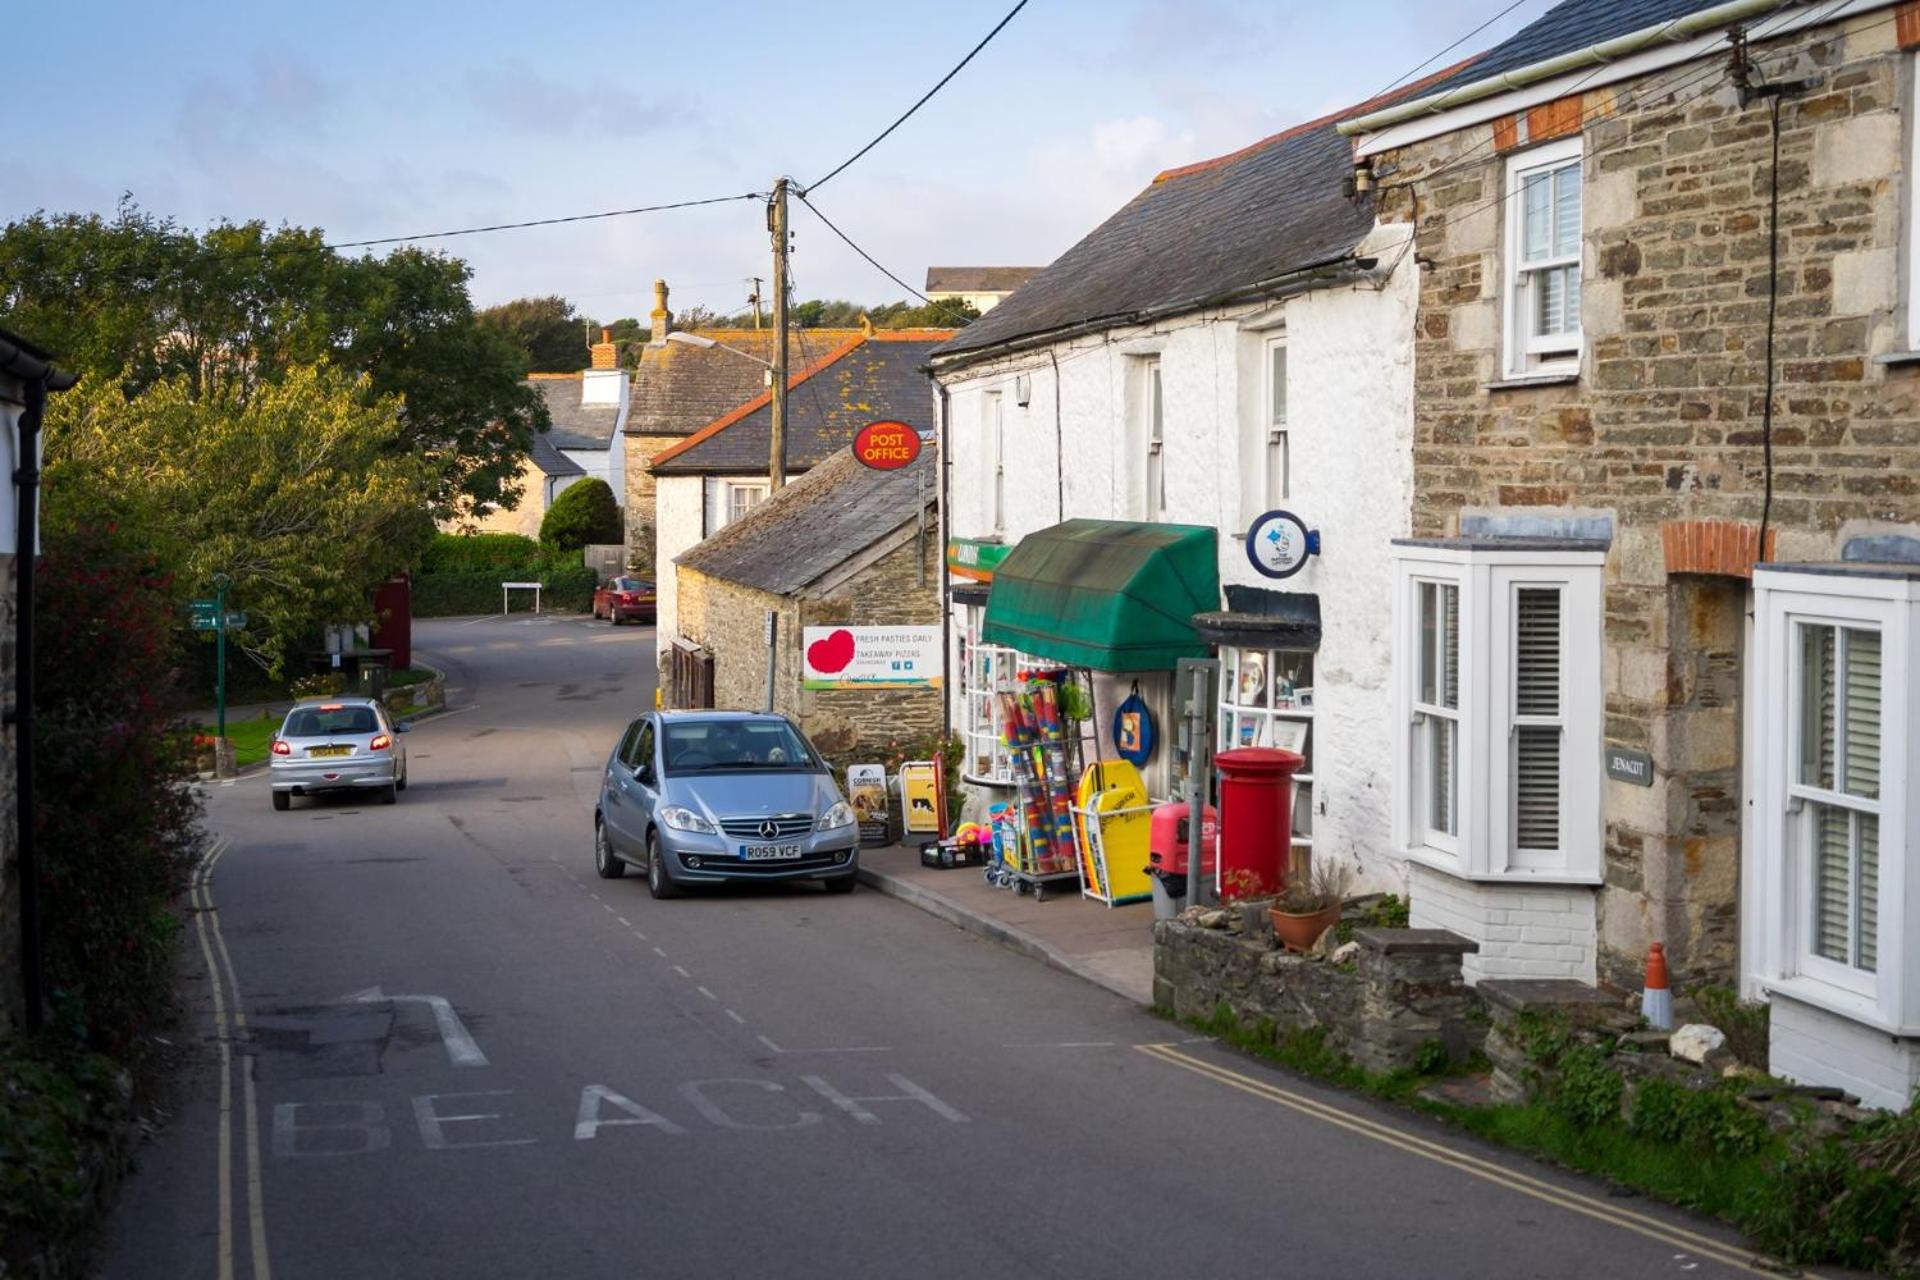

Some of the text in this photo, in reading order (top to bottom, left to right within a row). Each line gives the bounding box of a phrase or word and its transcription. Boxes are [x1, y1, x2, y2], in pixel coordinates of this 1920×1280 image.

[870, 433, 904, 447] POST
[863, 447, 910, 460] OFFICE
[856, 634, 933, 643] FRESH PASTIES DAILY
[856, 649, 920, 658] TAKEAWAY PIZZAS
[778, 845, 799, 857] VCF
[270, 1072, 971, 1157] BEACH
